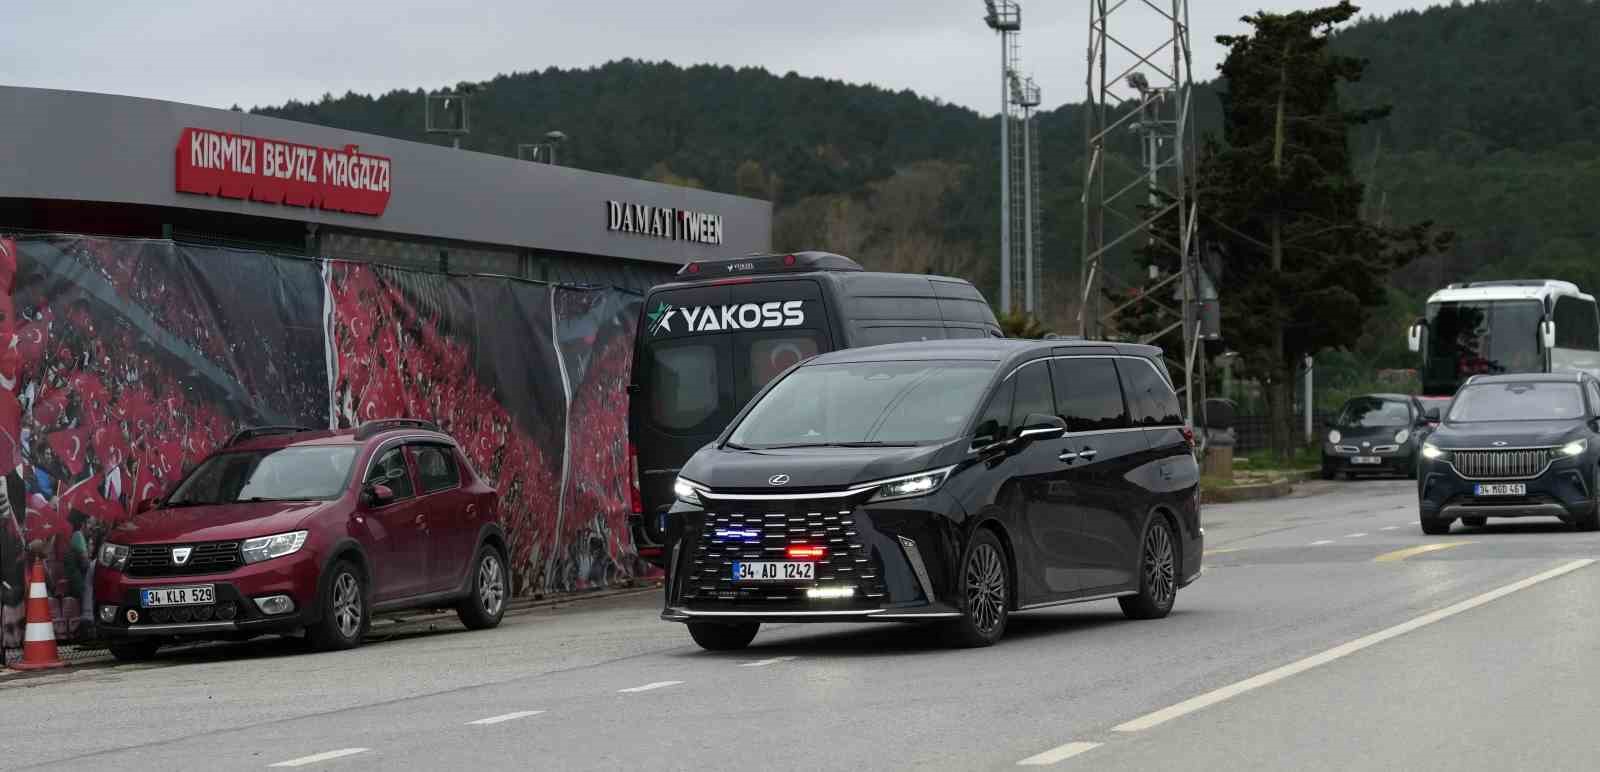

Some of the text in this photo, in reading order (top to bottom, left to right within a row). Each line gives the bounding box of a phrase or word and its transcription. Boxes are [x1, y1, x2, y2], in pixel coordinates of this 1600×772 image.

[191, 131, 390, 192] KIRMIZI BEYAZ MAĞAZA
[680, 300, 805, 332] YAKOSS
[740, 563, 812, 578] 34 AD 1242
[149, 588, 212, 604] 34 KLR 529
